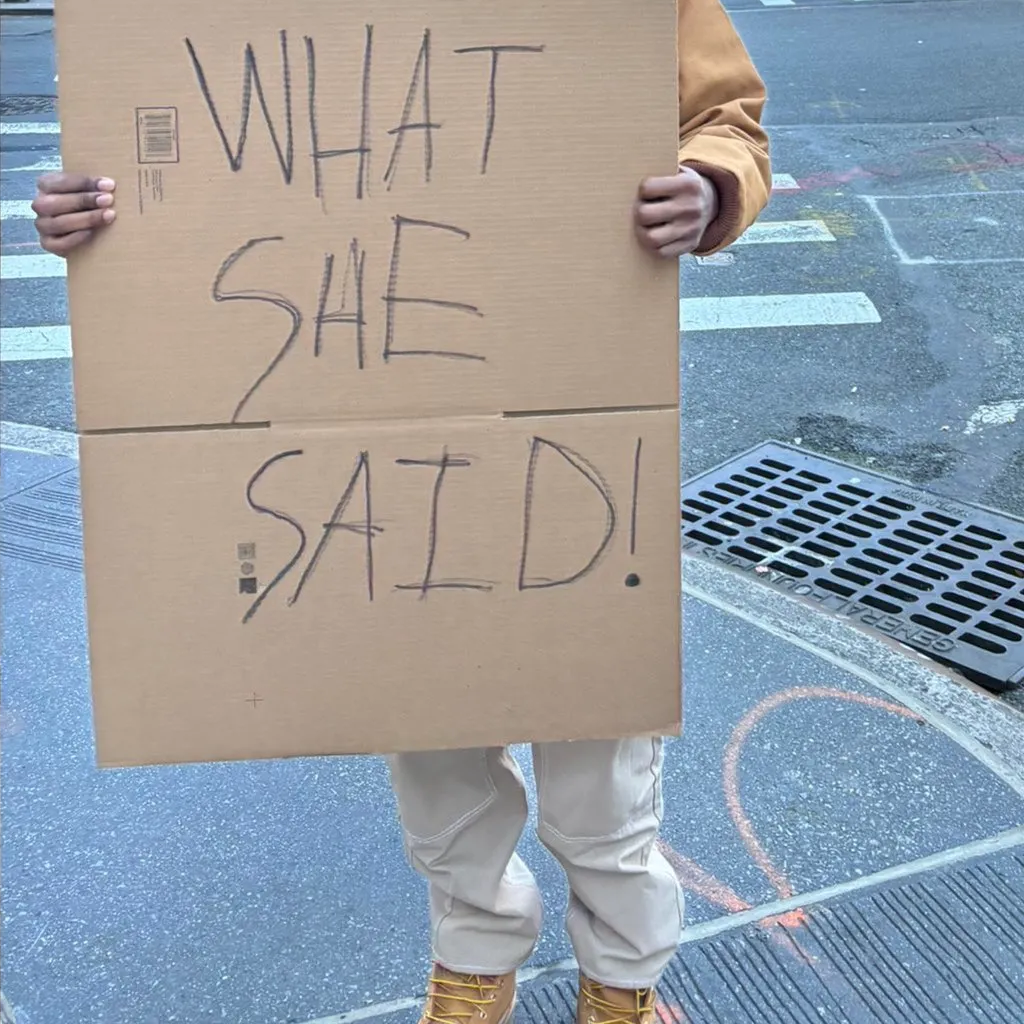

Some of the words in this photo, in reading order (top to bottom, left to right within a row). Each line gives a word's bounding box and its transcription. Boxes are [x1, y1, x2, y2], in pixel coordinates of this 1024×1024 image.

[184, 24, 547, 216] WHAT
[213, 214, 487, 423] SHE
[242, 436, 641, 624] SAID!
[834, 595, 956, 652] GENERAL
